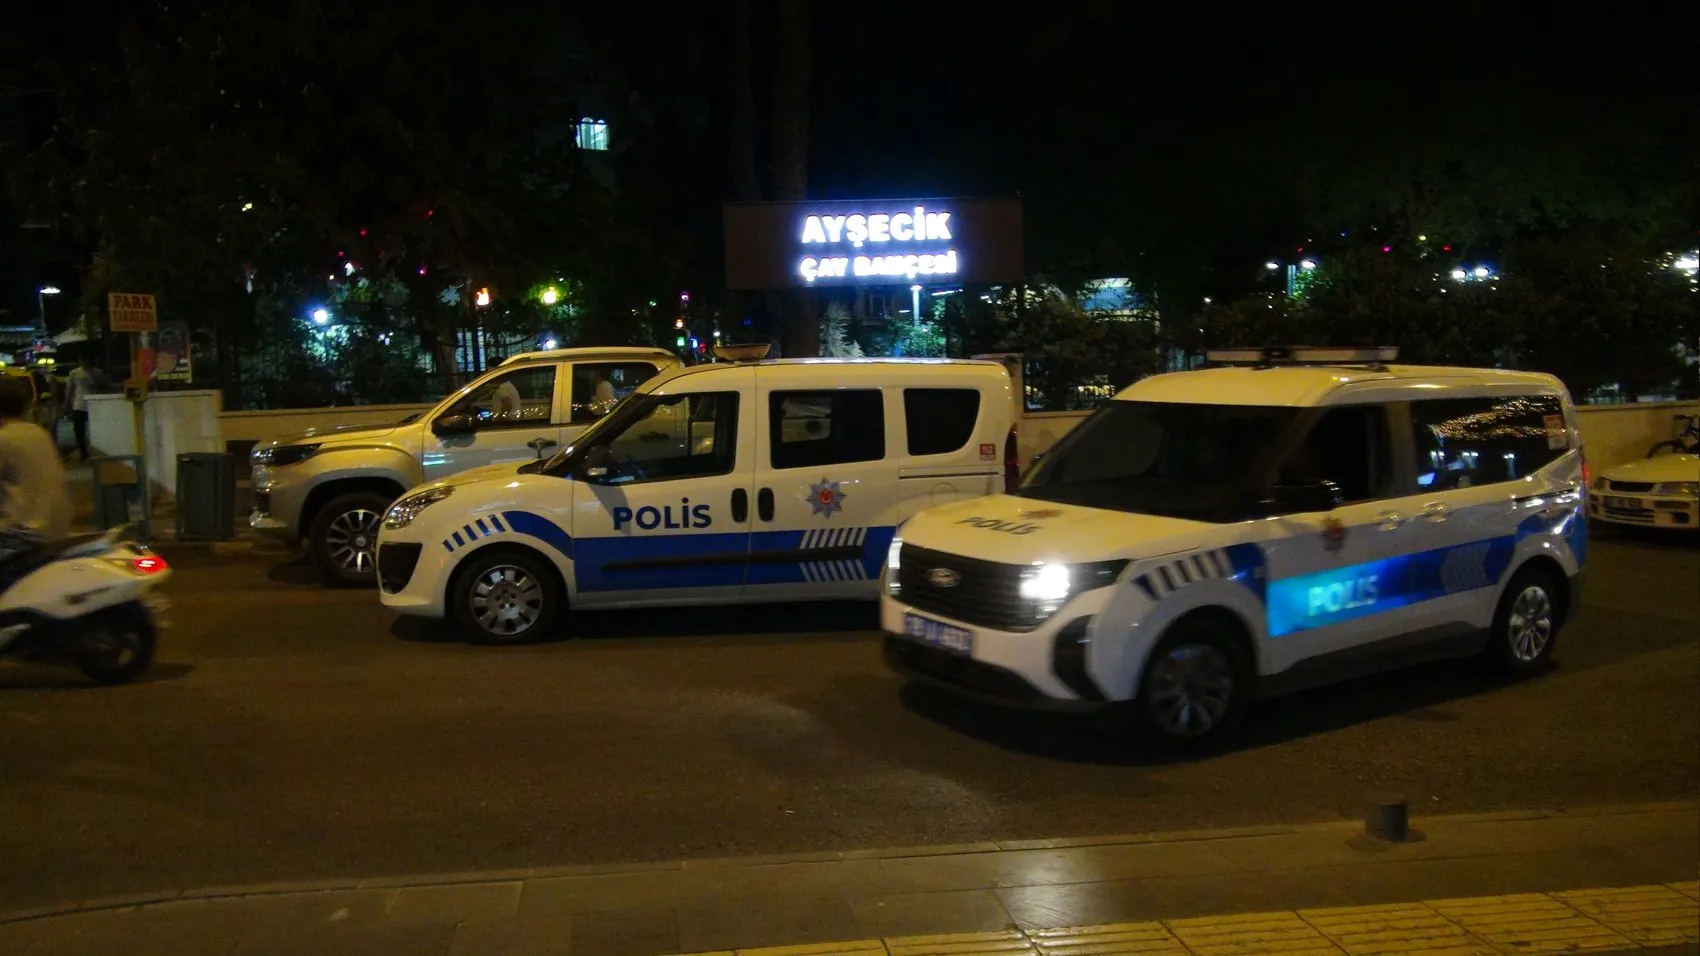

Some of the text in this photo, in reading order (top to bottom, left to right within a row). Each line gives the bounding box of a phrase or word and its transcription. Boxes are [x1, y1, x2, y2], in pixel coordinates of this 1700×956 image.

[801, 204, 952, 248] AYŞECİK
[800, 257, 849, 282] ÇAY
[113, 295, 152, 309] PARK
[613, 496, 712, 531] POLİS
